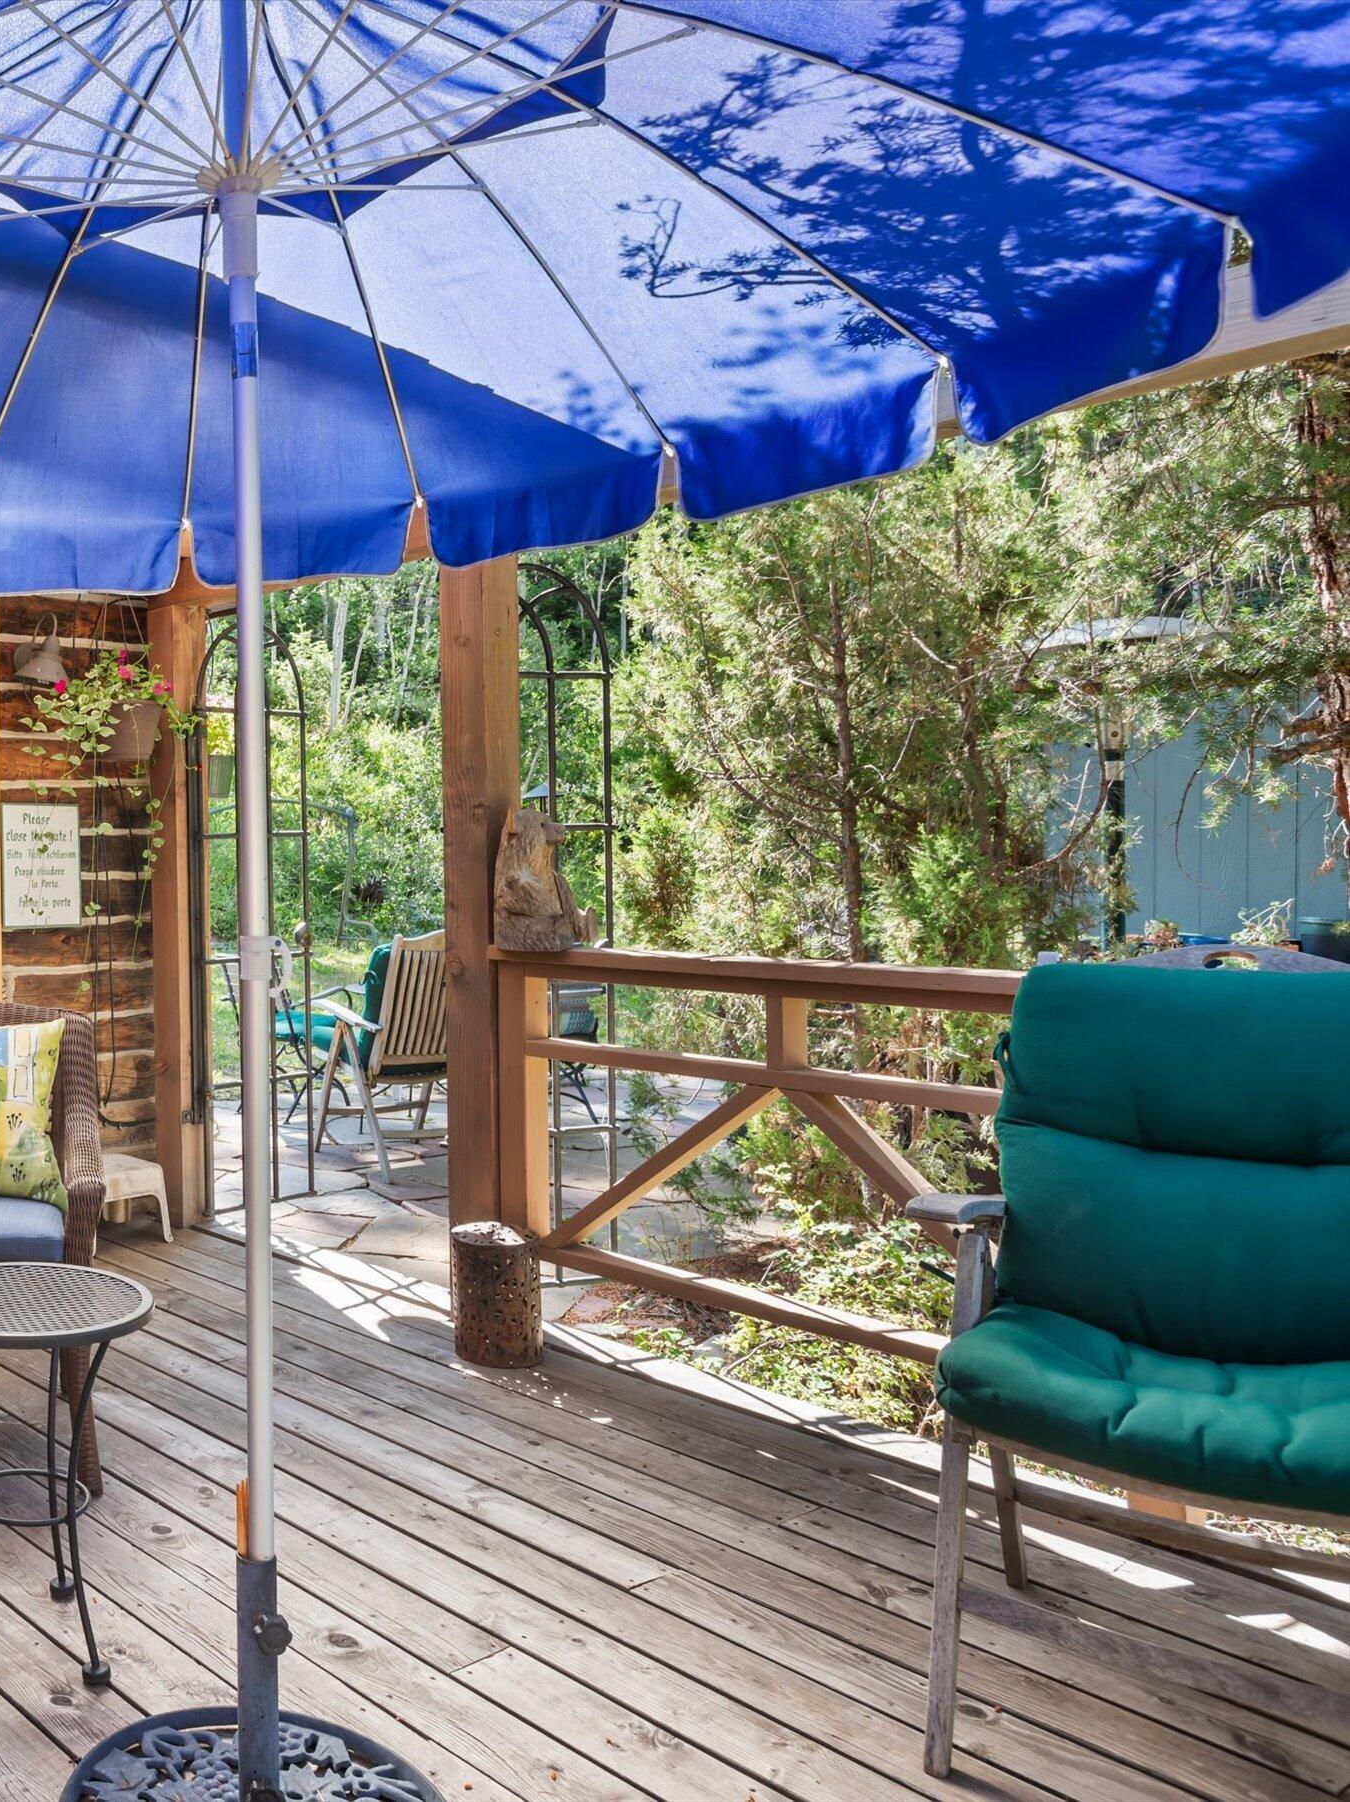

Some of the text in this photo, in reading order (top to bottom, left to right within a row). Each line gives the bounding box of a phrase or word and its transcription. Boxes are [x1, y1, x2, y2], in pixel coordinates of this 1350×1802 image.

[23, 813, 50, 825] Please
[6, 829, 27, 842] close
[31, 829, 43, 842] the
[15, 866, 34, 878] Prego
[32, 880, 38, 888] la
[42, 897, 49, 907] la
[53, 898, 71, 908] porte
